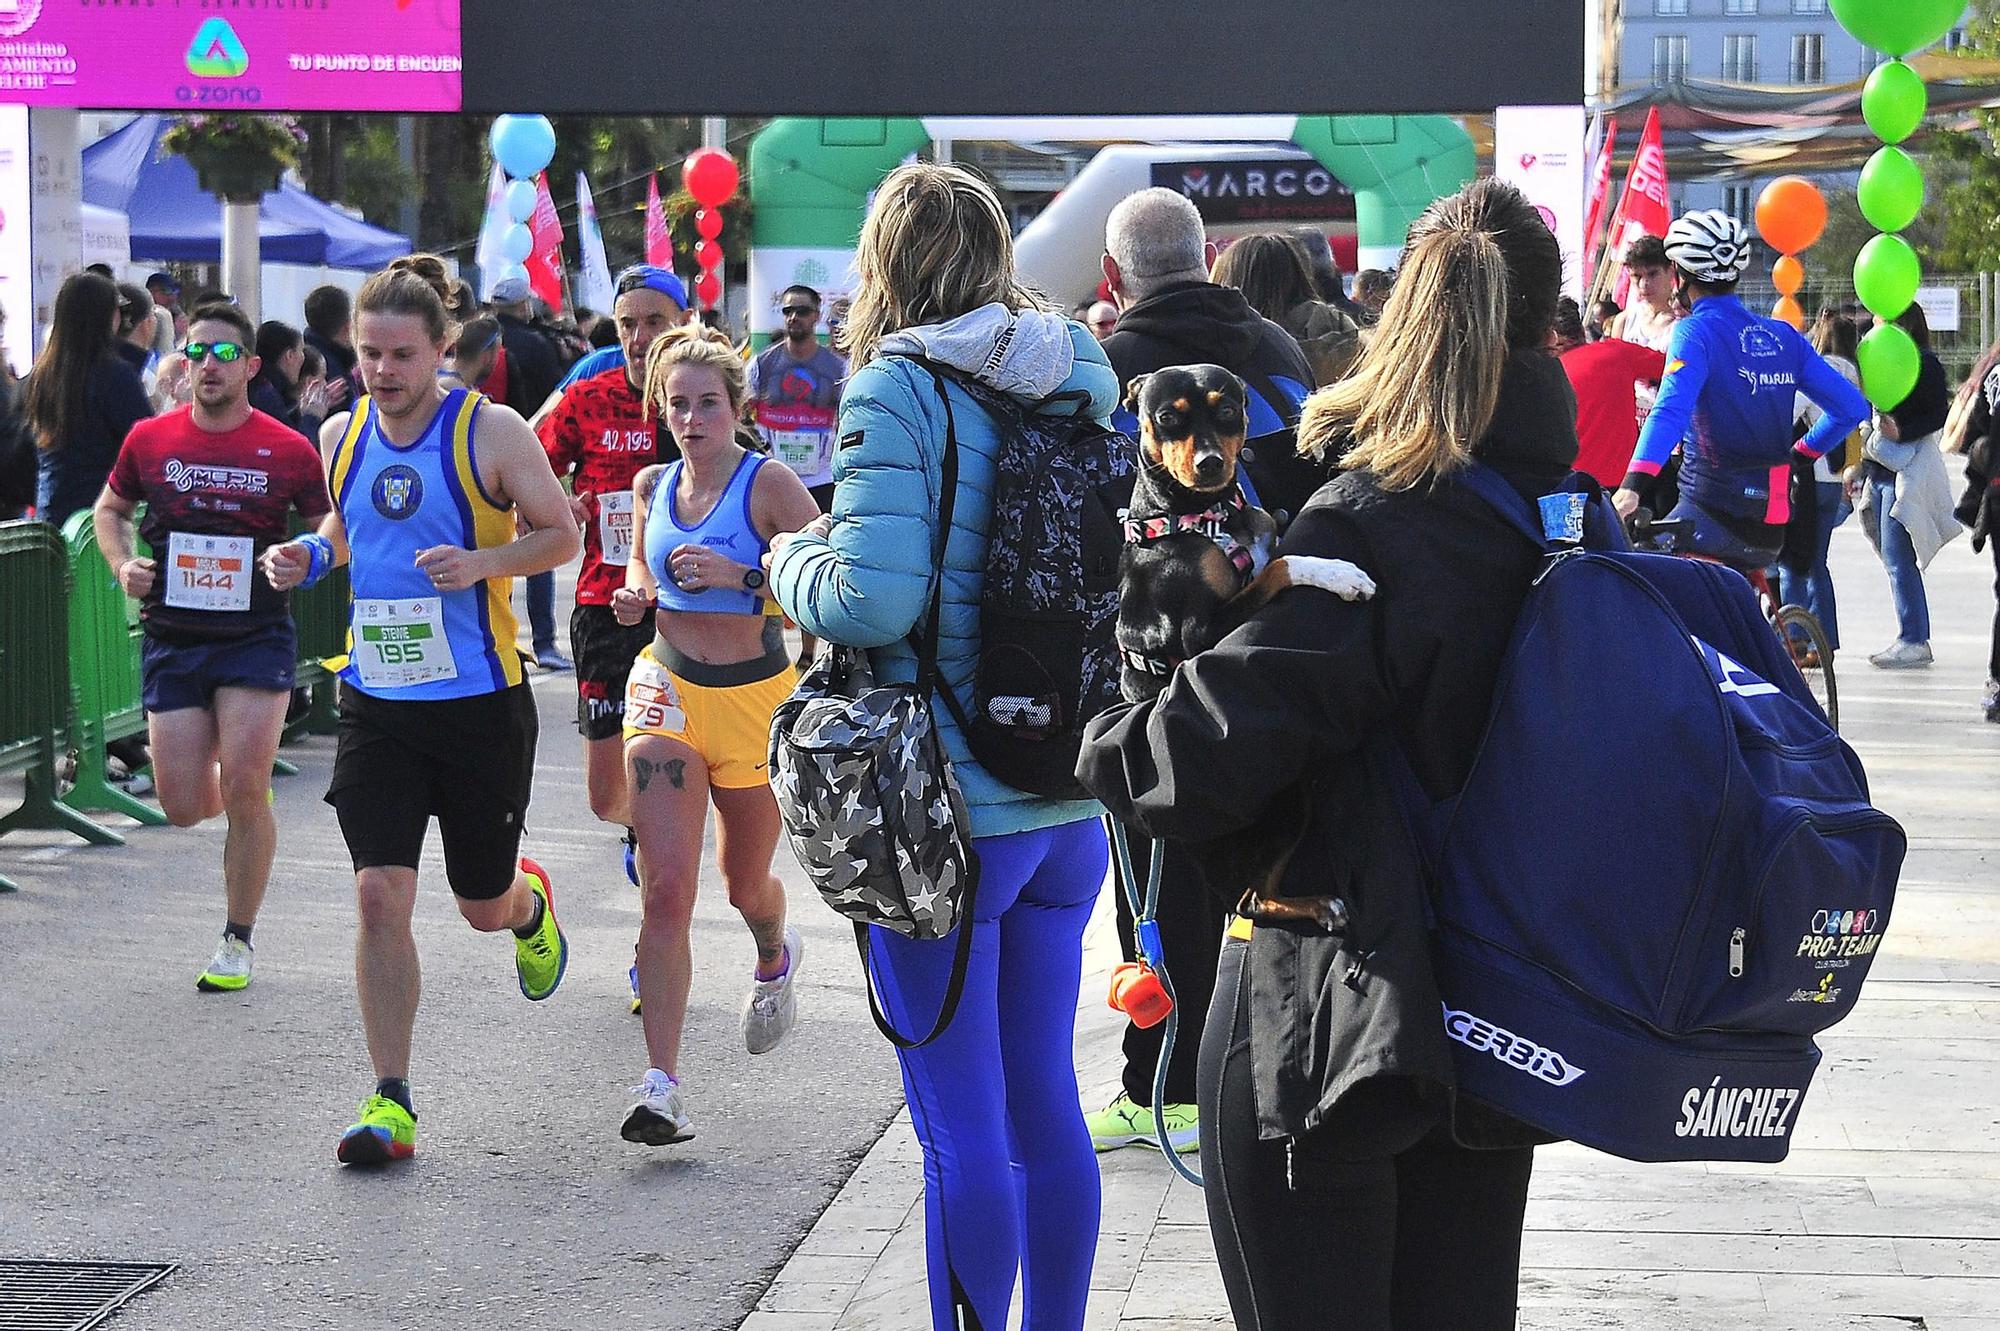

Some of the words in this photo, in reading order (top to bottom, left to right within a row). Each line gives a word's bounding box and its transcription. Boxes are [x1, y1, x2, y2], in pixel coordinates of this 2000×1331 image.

[291, 53, 312, 71] TU
[314, 53, 371, 71] PUNTO
[372, 54, 395, 72] DE
[183, 571, 234, 591] 1144
[375, 643, 425, 663] 195
[1795, 934, 1881, 958] PRO-TEAM
[1675, 1074, 1800, 1137] SÁNCHEZ
